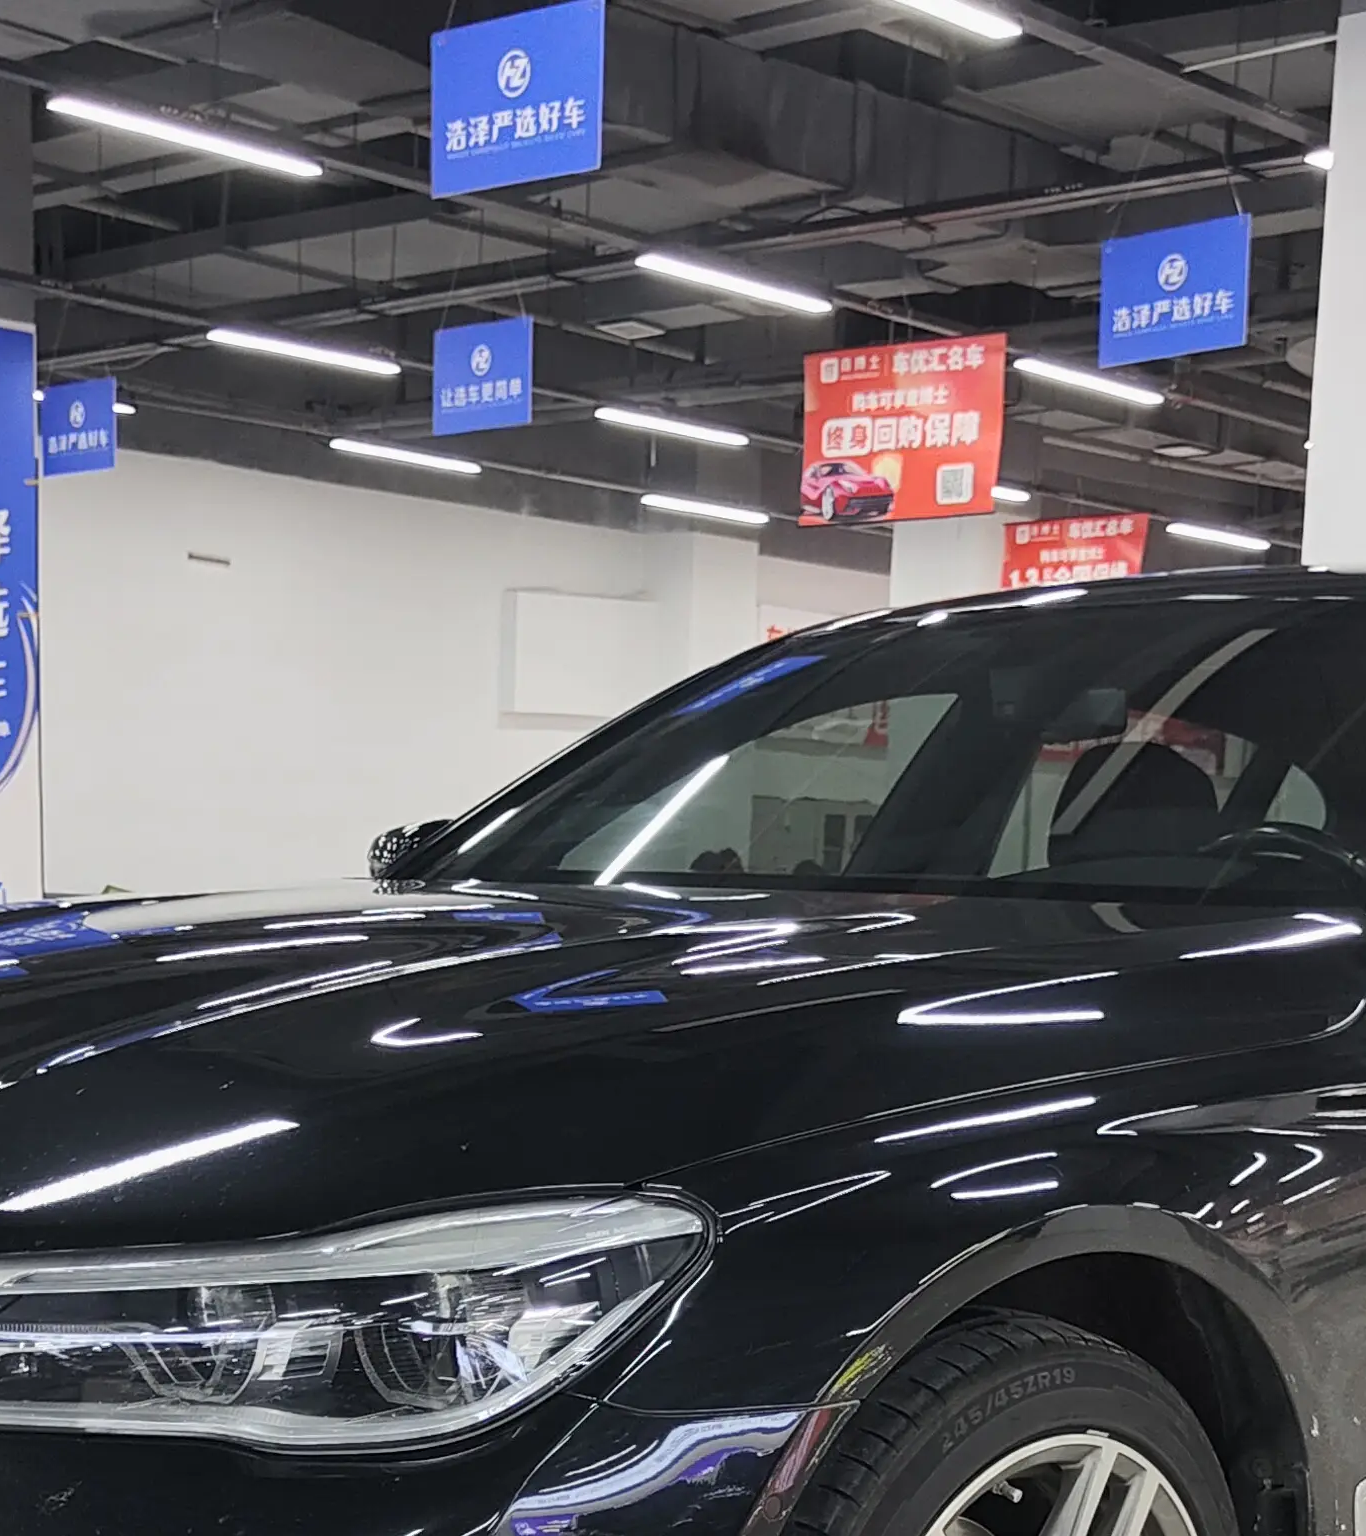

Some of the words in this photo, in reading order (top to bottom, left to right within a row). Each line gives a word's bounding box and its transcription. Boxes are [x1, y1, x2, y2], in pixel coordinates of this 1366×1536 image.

[445, 96, 586, 152] 浩泽严选好车
[1111, 289, 1235, 333] 浩泽严选好车
[892, 344, 986, 376] 车优汇名车
[440, 377, 523, 408] 让选车更简单
[47, 428, 109, 454] 浩泽严选好车
[939, 1366, 1077, 1455] 245/45ZR19
